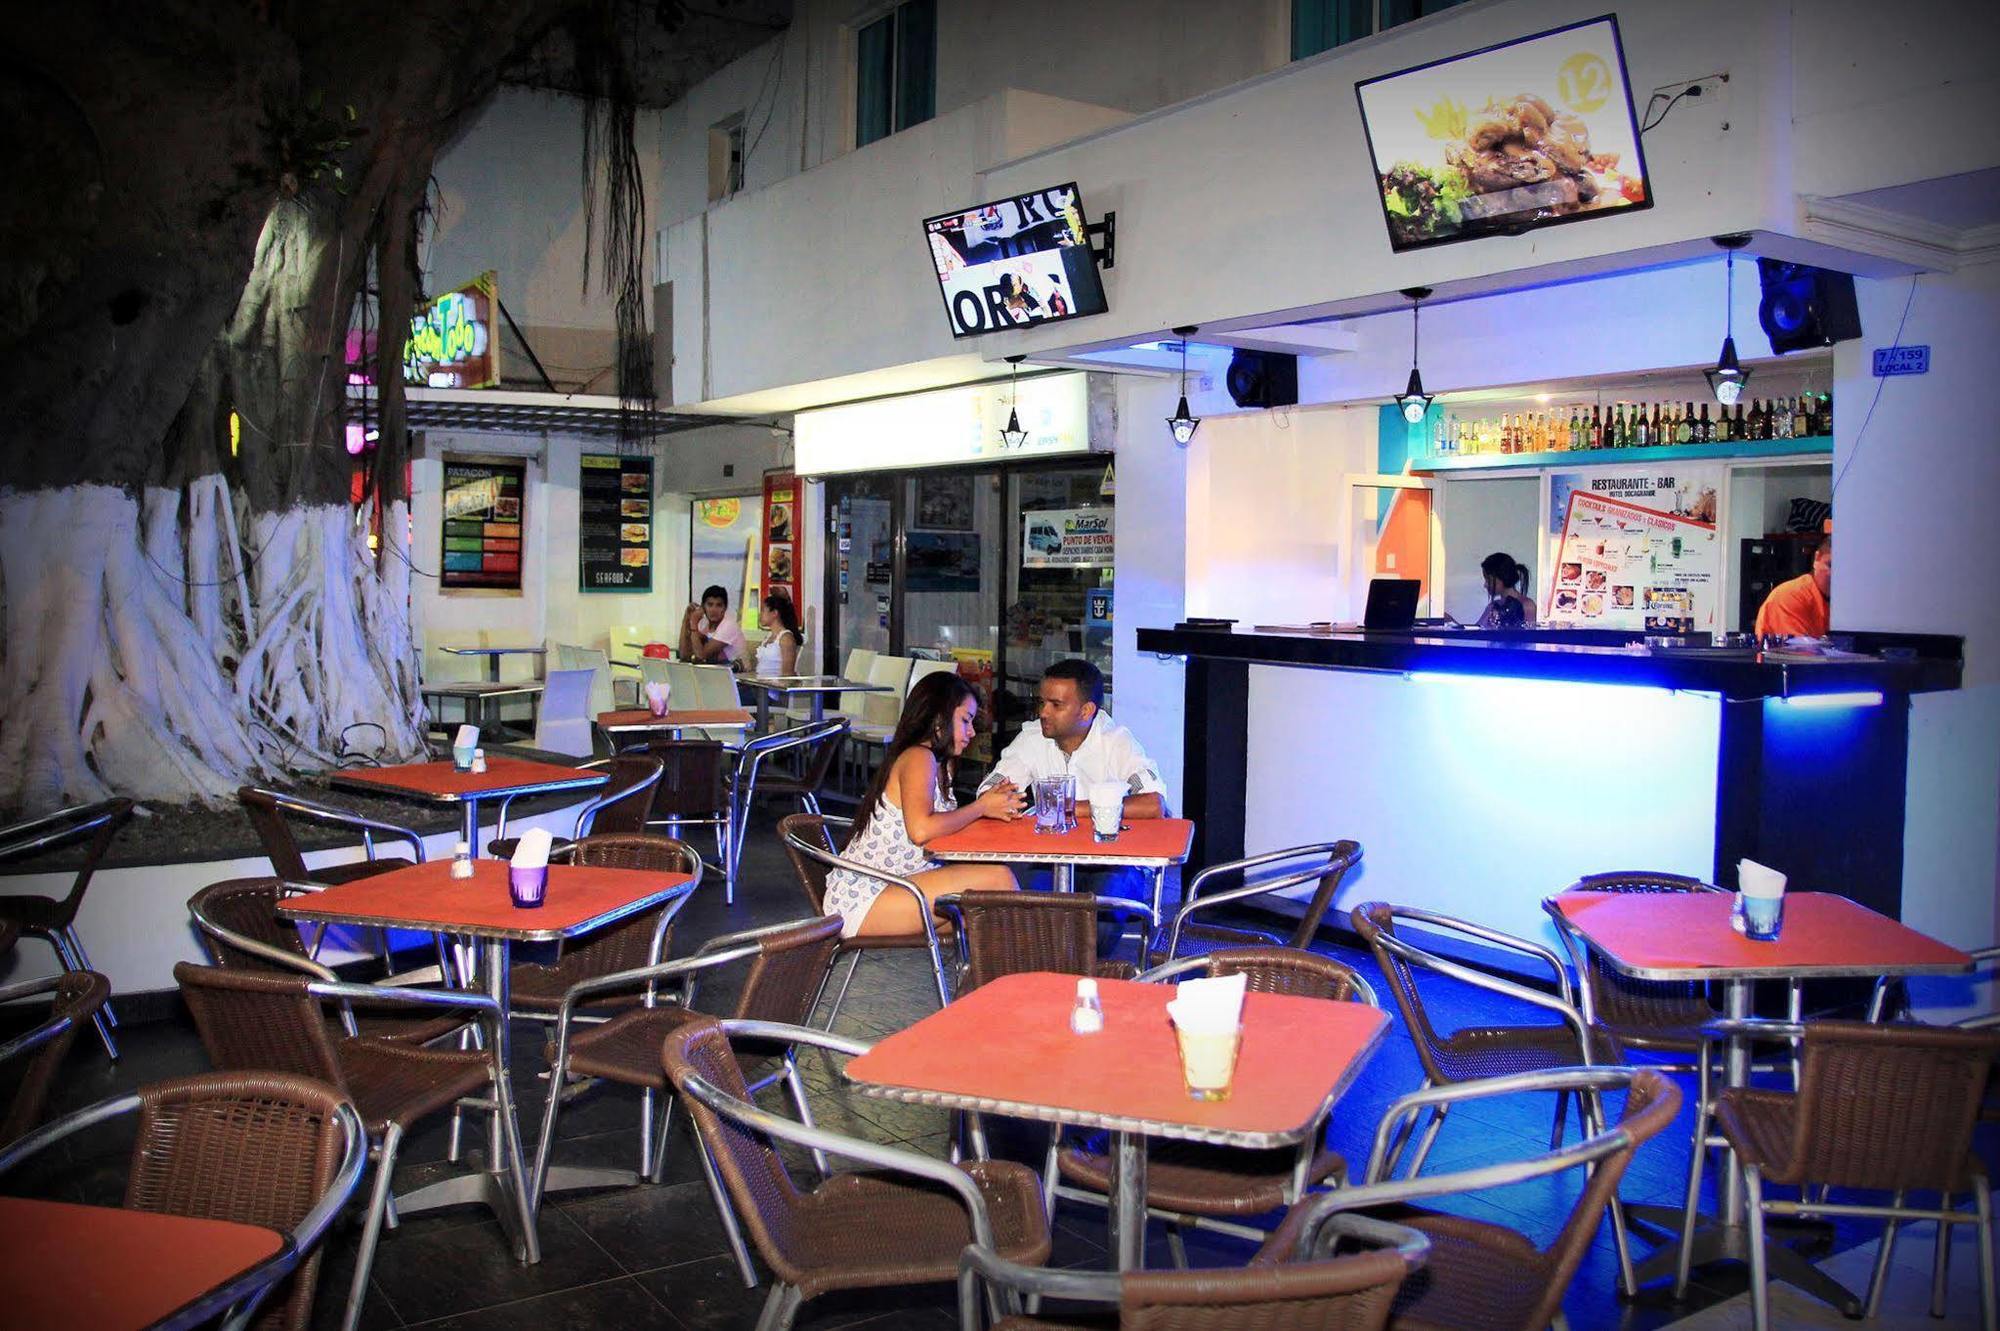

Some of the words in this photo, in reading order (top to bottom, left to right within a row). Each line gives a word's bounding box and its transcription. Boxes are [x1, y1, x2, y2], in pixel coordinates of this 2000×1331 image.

[1560, 61, 1609, 104] 12
[1878, 362, 1913, 373] LOCAL
[1915, 362, 1923, 370] 2
[1592, 478, 1649, 490] RESTAURANTE
[1657, 477, 1676, 489] BAR
[1075, 517, 1109, 530] MarSol
[1063, 535, 1082, 546] PUNTO
[1083, 535, 1092, 545] DE
[1093, 534, 1114, 545] VENTA
[595, 572, 624, 584] SEAFOOD
